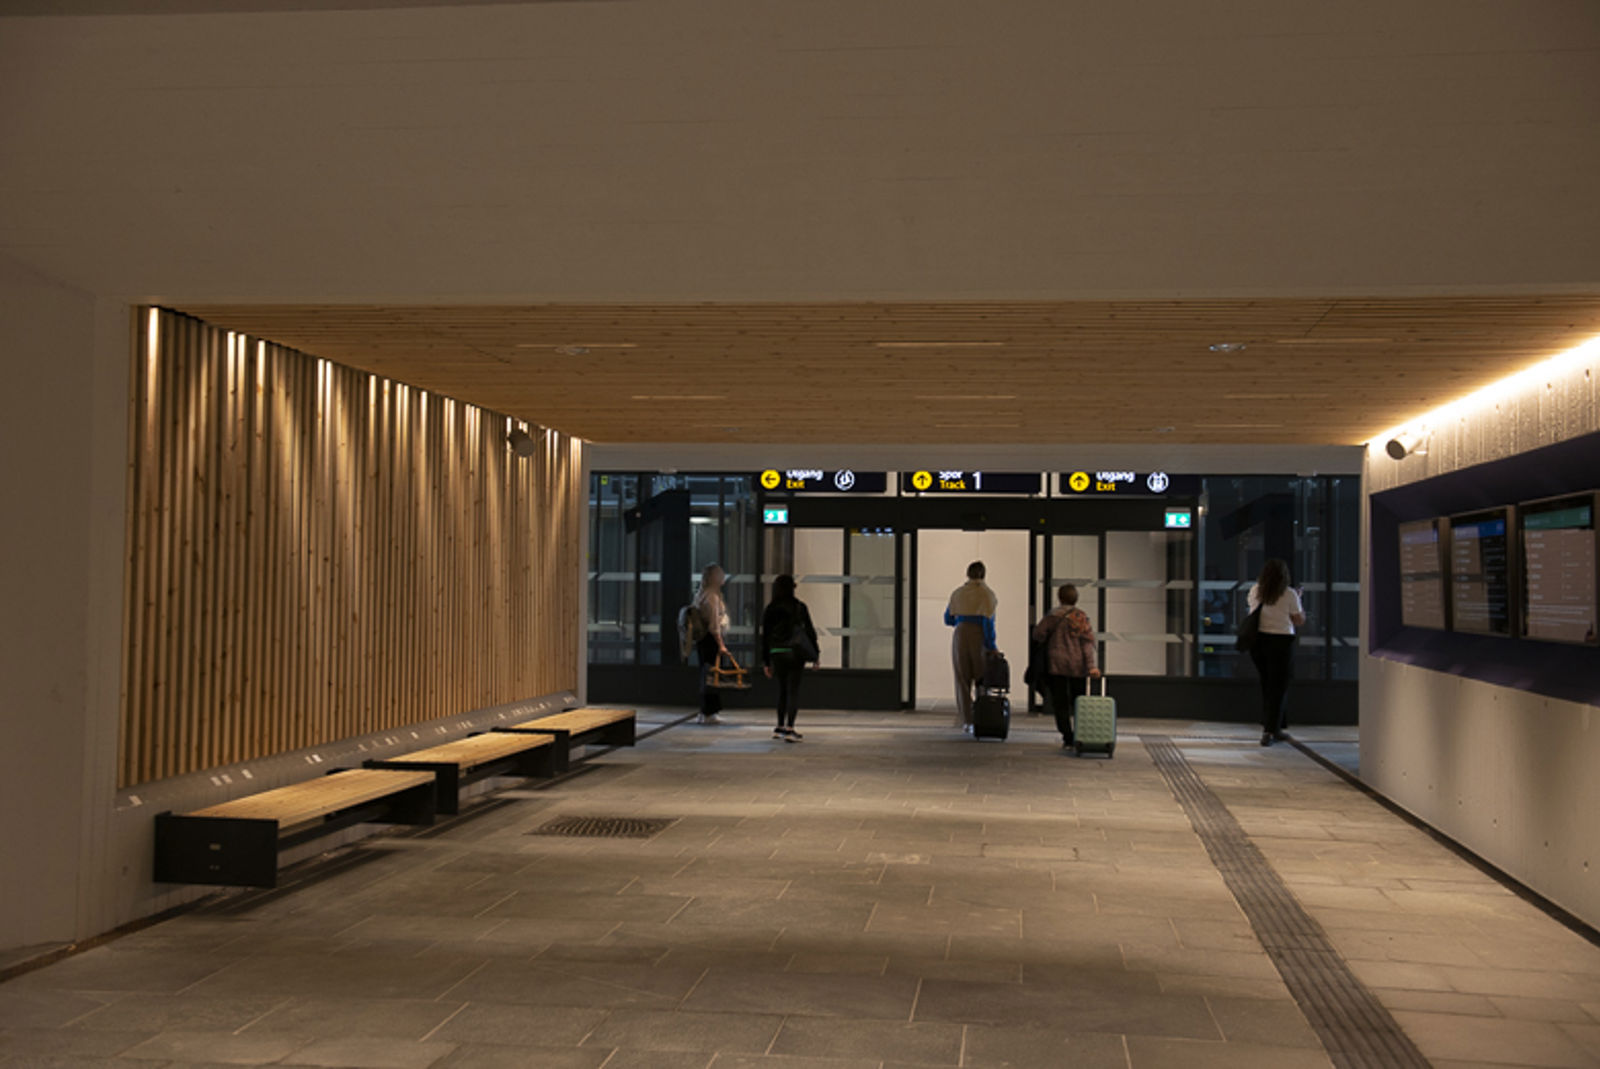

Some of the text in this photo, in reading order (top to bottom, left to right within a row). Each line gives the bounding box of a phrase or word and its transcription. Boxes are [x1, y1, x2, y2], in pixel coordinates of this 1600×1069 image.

[786, 480, 805, 489] Exit
[939, 480, 966, 490] Track
[972, 471, 982, 490] 1
[1096, 481, 1115, 491] Exit
